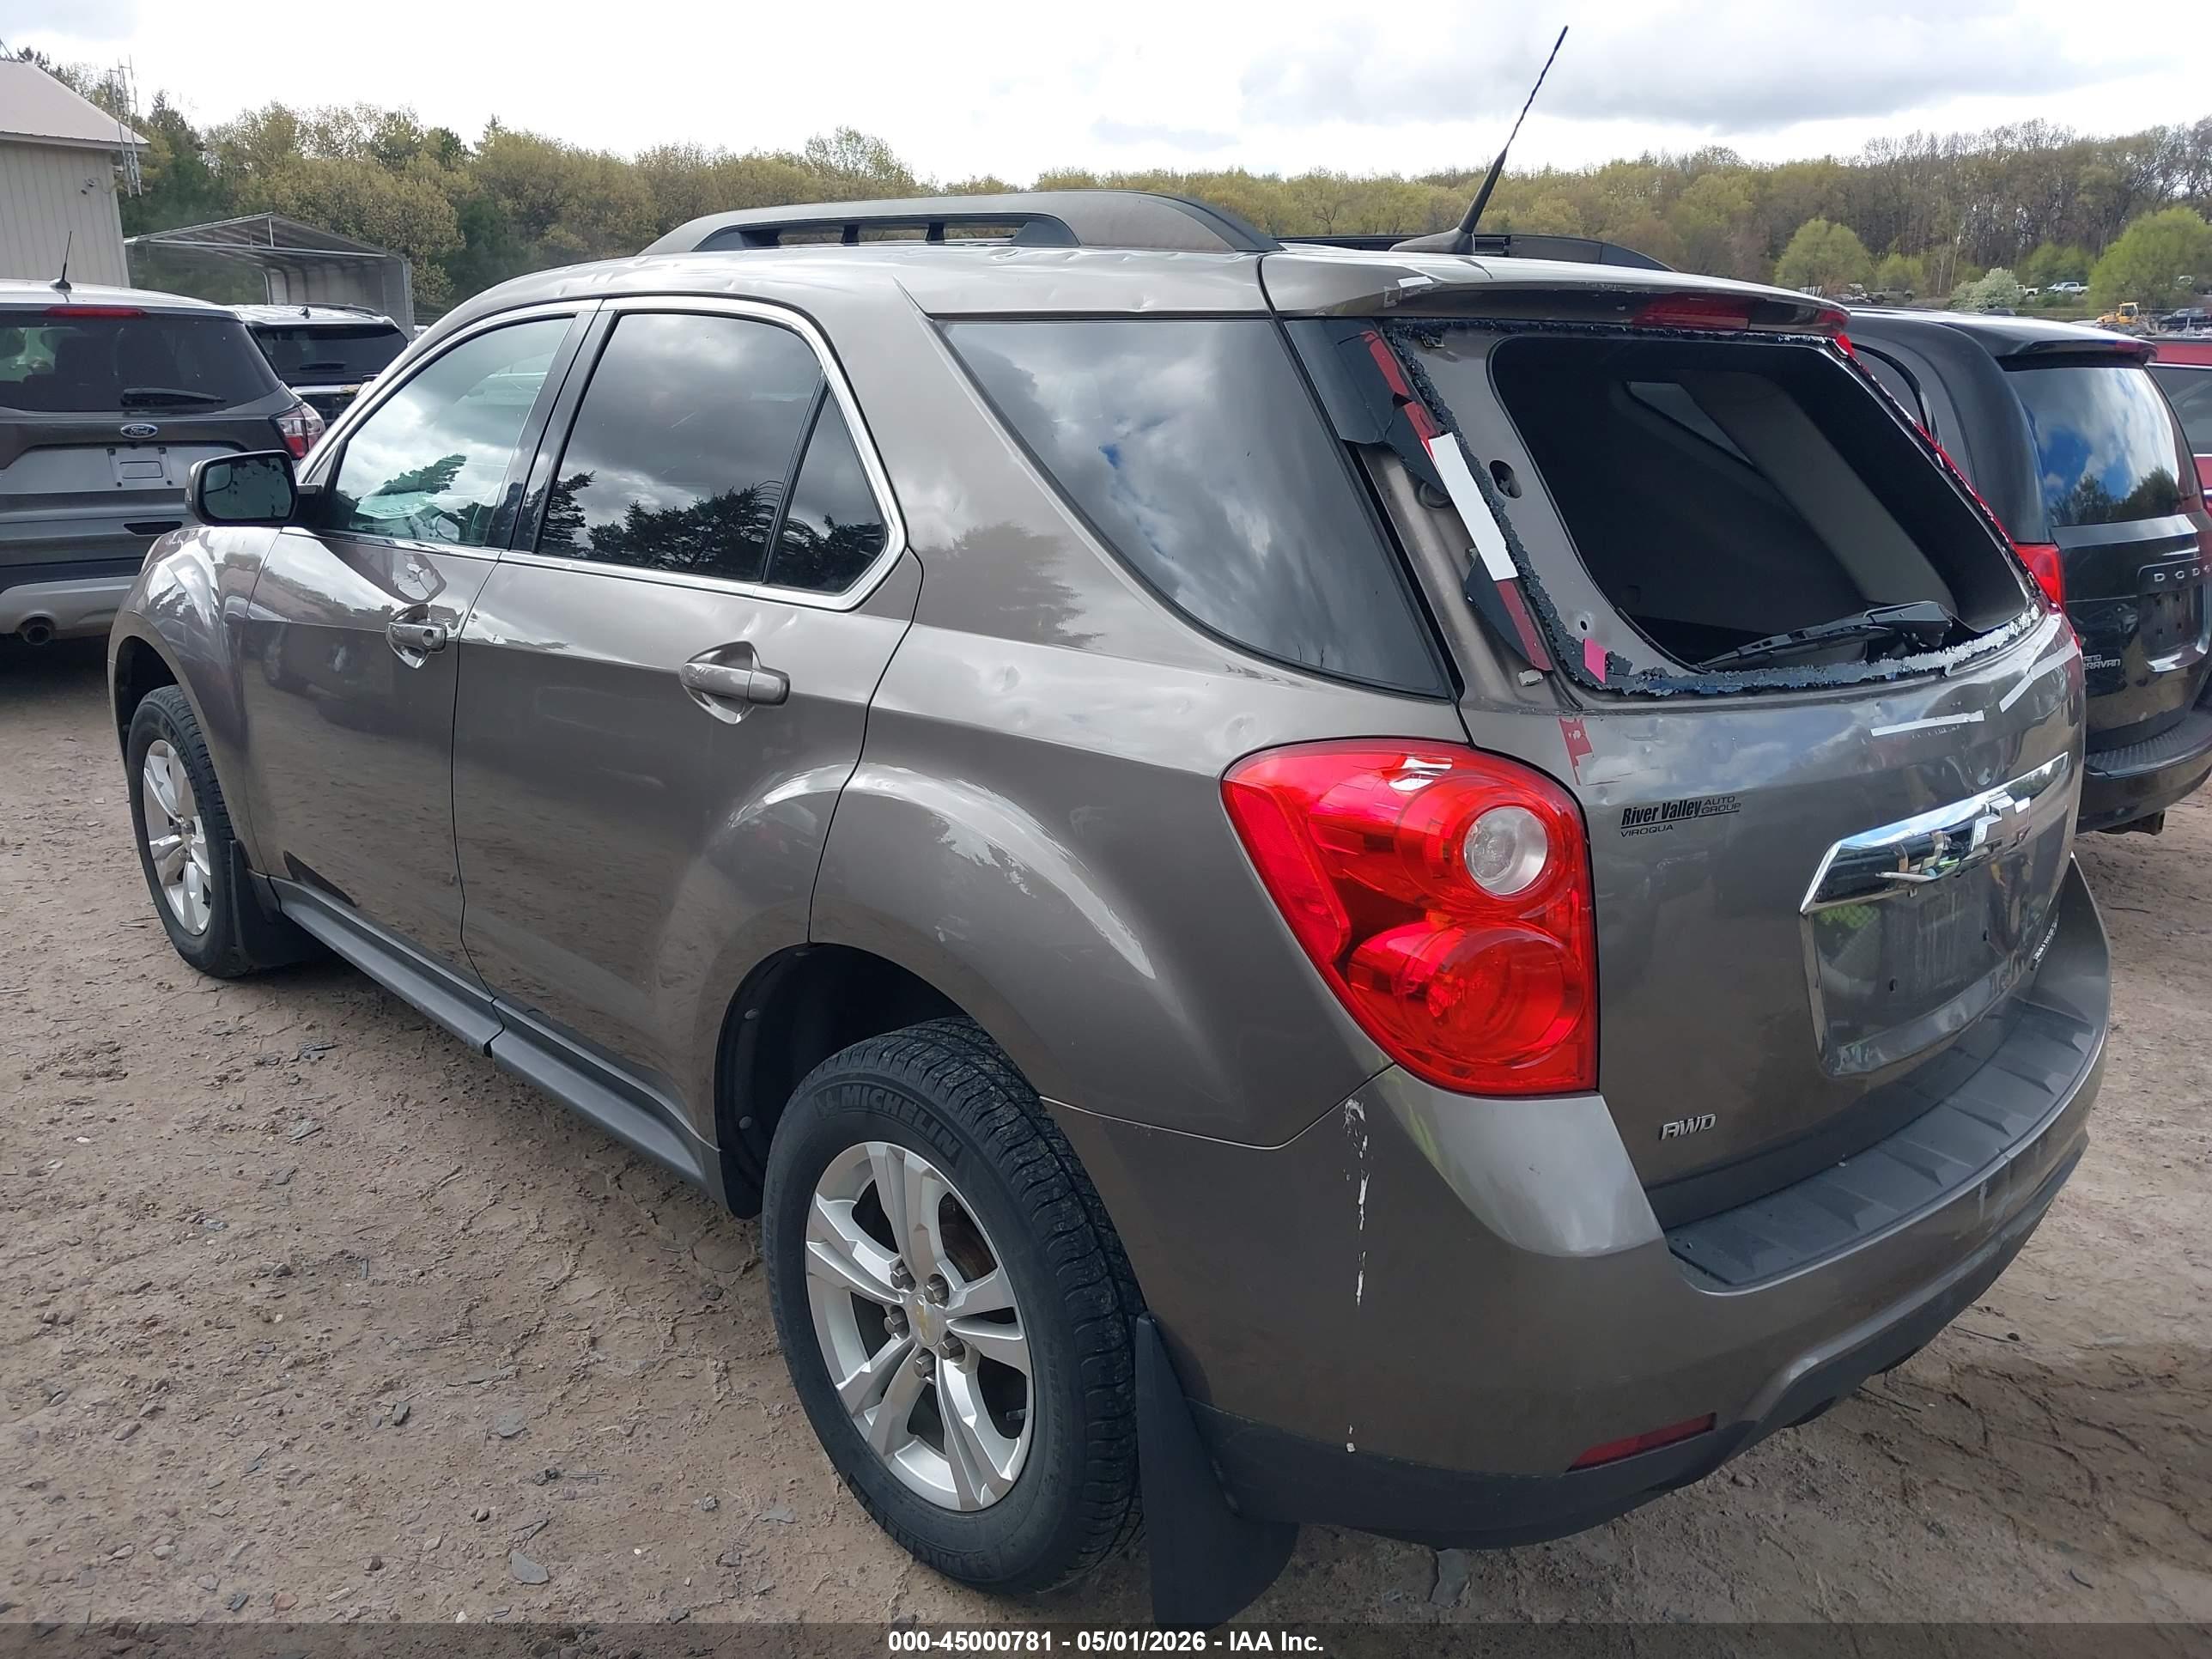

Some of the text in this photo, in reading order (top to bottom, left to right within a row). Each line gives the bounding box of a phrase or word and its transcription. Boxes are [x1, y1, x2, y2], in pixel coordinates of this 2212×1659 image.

[1701, 803, 1741, 814] GROUP
[1703, 796, 1735, 806] AUTO
[1621, 799, 1702, 826] River Valley
[1621, 823, 1674, 837] VIROQUA
[840, 1085, 963, 1159] MICHELIN
[1661, 1114, 1717, 1140] AWD
